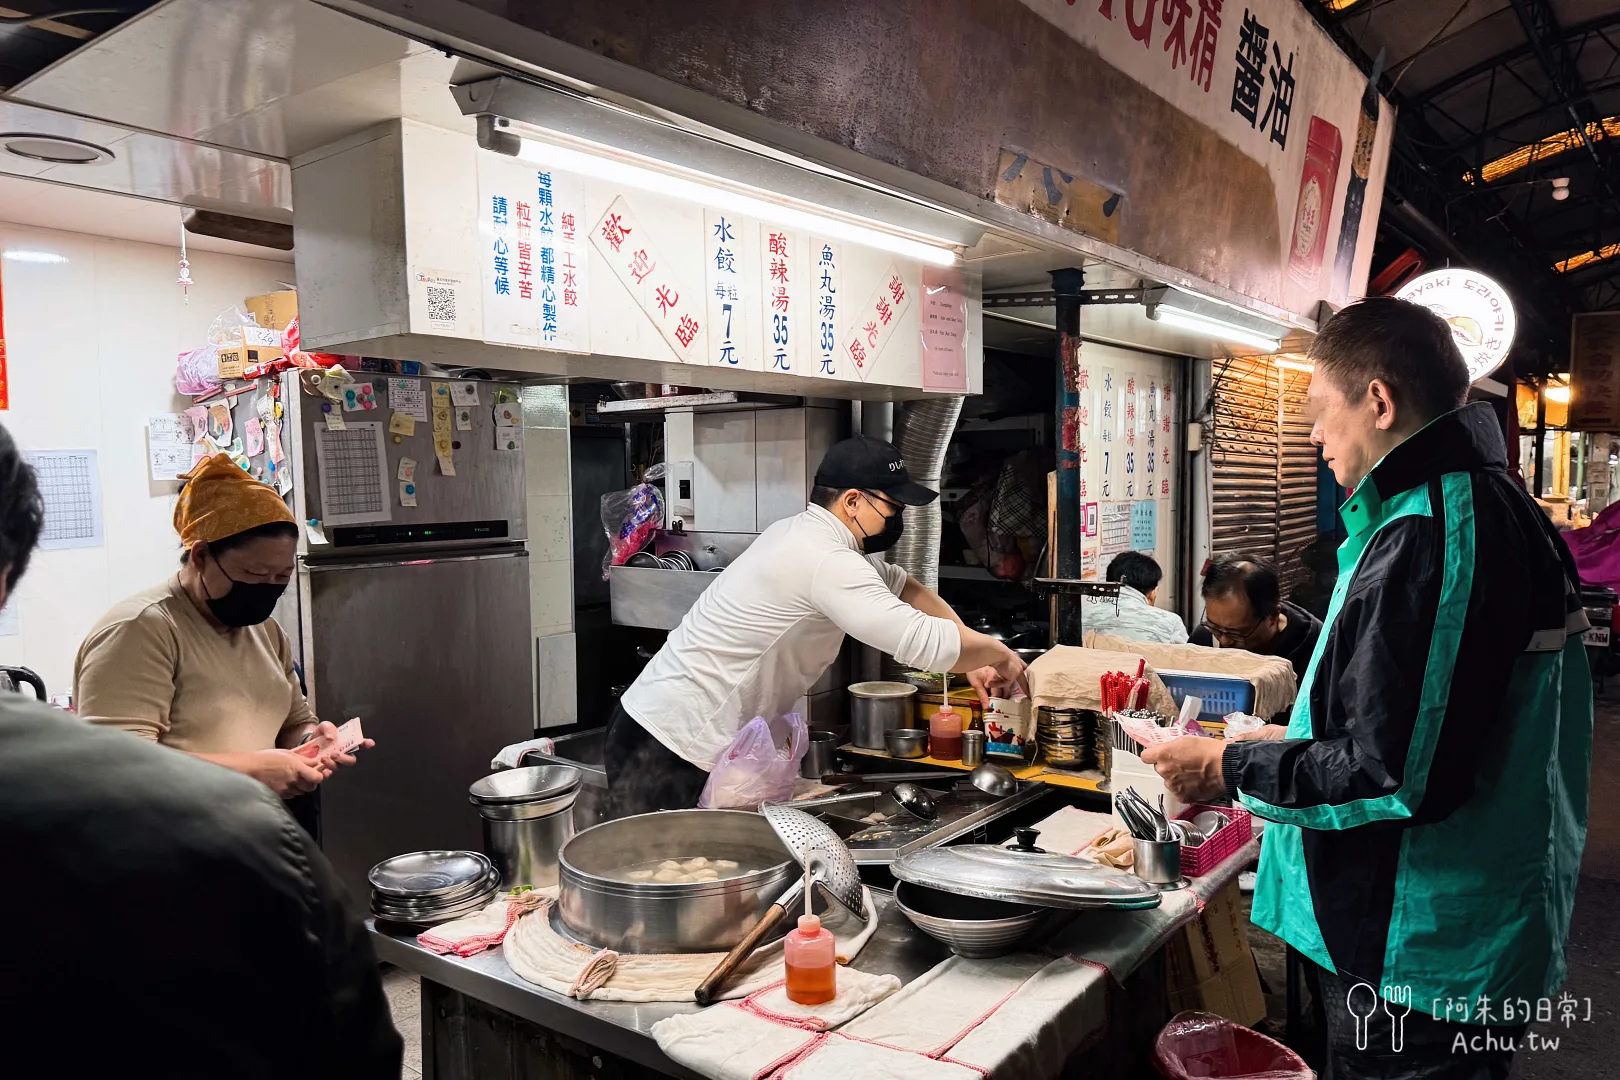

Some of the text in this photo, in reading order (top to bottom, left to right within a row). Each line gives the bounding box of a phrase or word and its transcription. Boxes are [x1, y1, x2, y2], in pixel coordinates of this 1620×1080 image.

[1230, 7, 1296, 151] 醬油
[601, 212, 700, 349] 歡迎光臨
[768, 232, 791, 372] 酸辣湯35元
[817, 244, 837, 376] 魚丸湯35元
[849, 275, 906, 369] 謝謝光臨
[1406, 277, 1451, 301] ayaki
[1463, 279, 1505, 332] 도라야키
